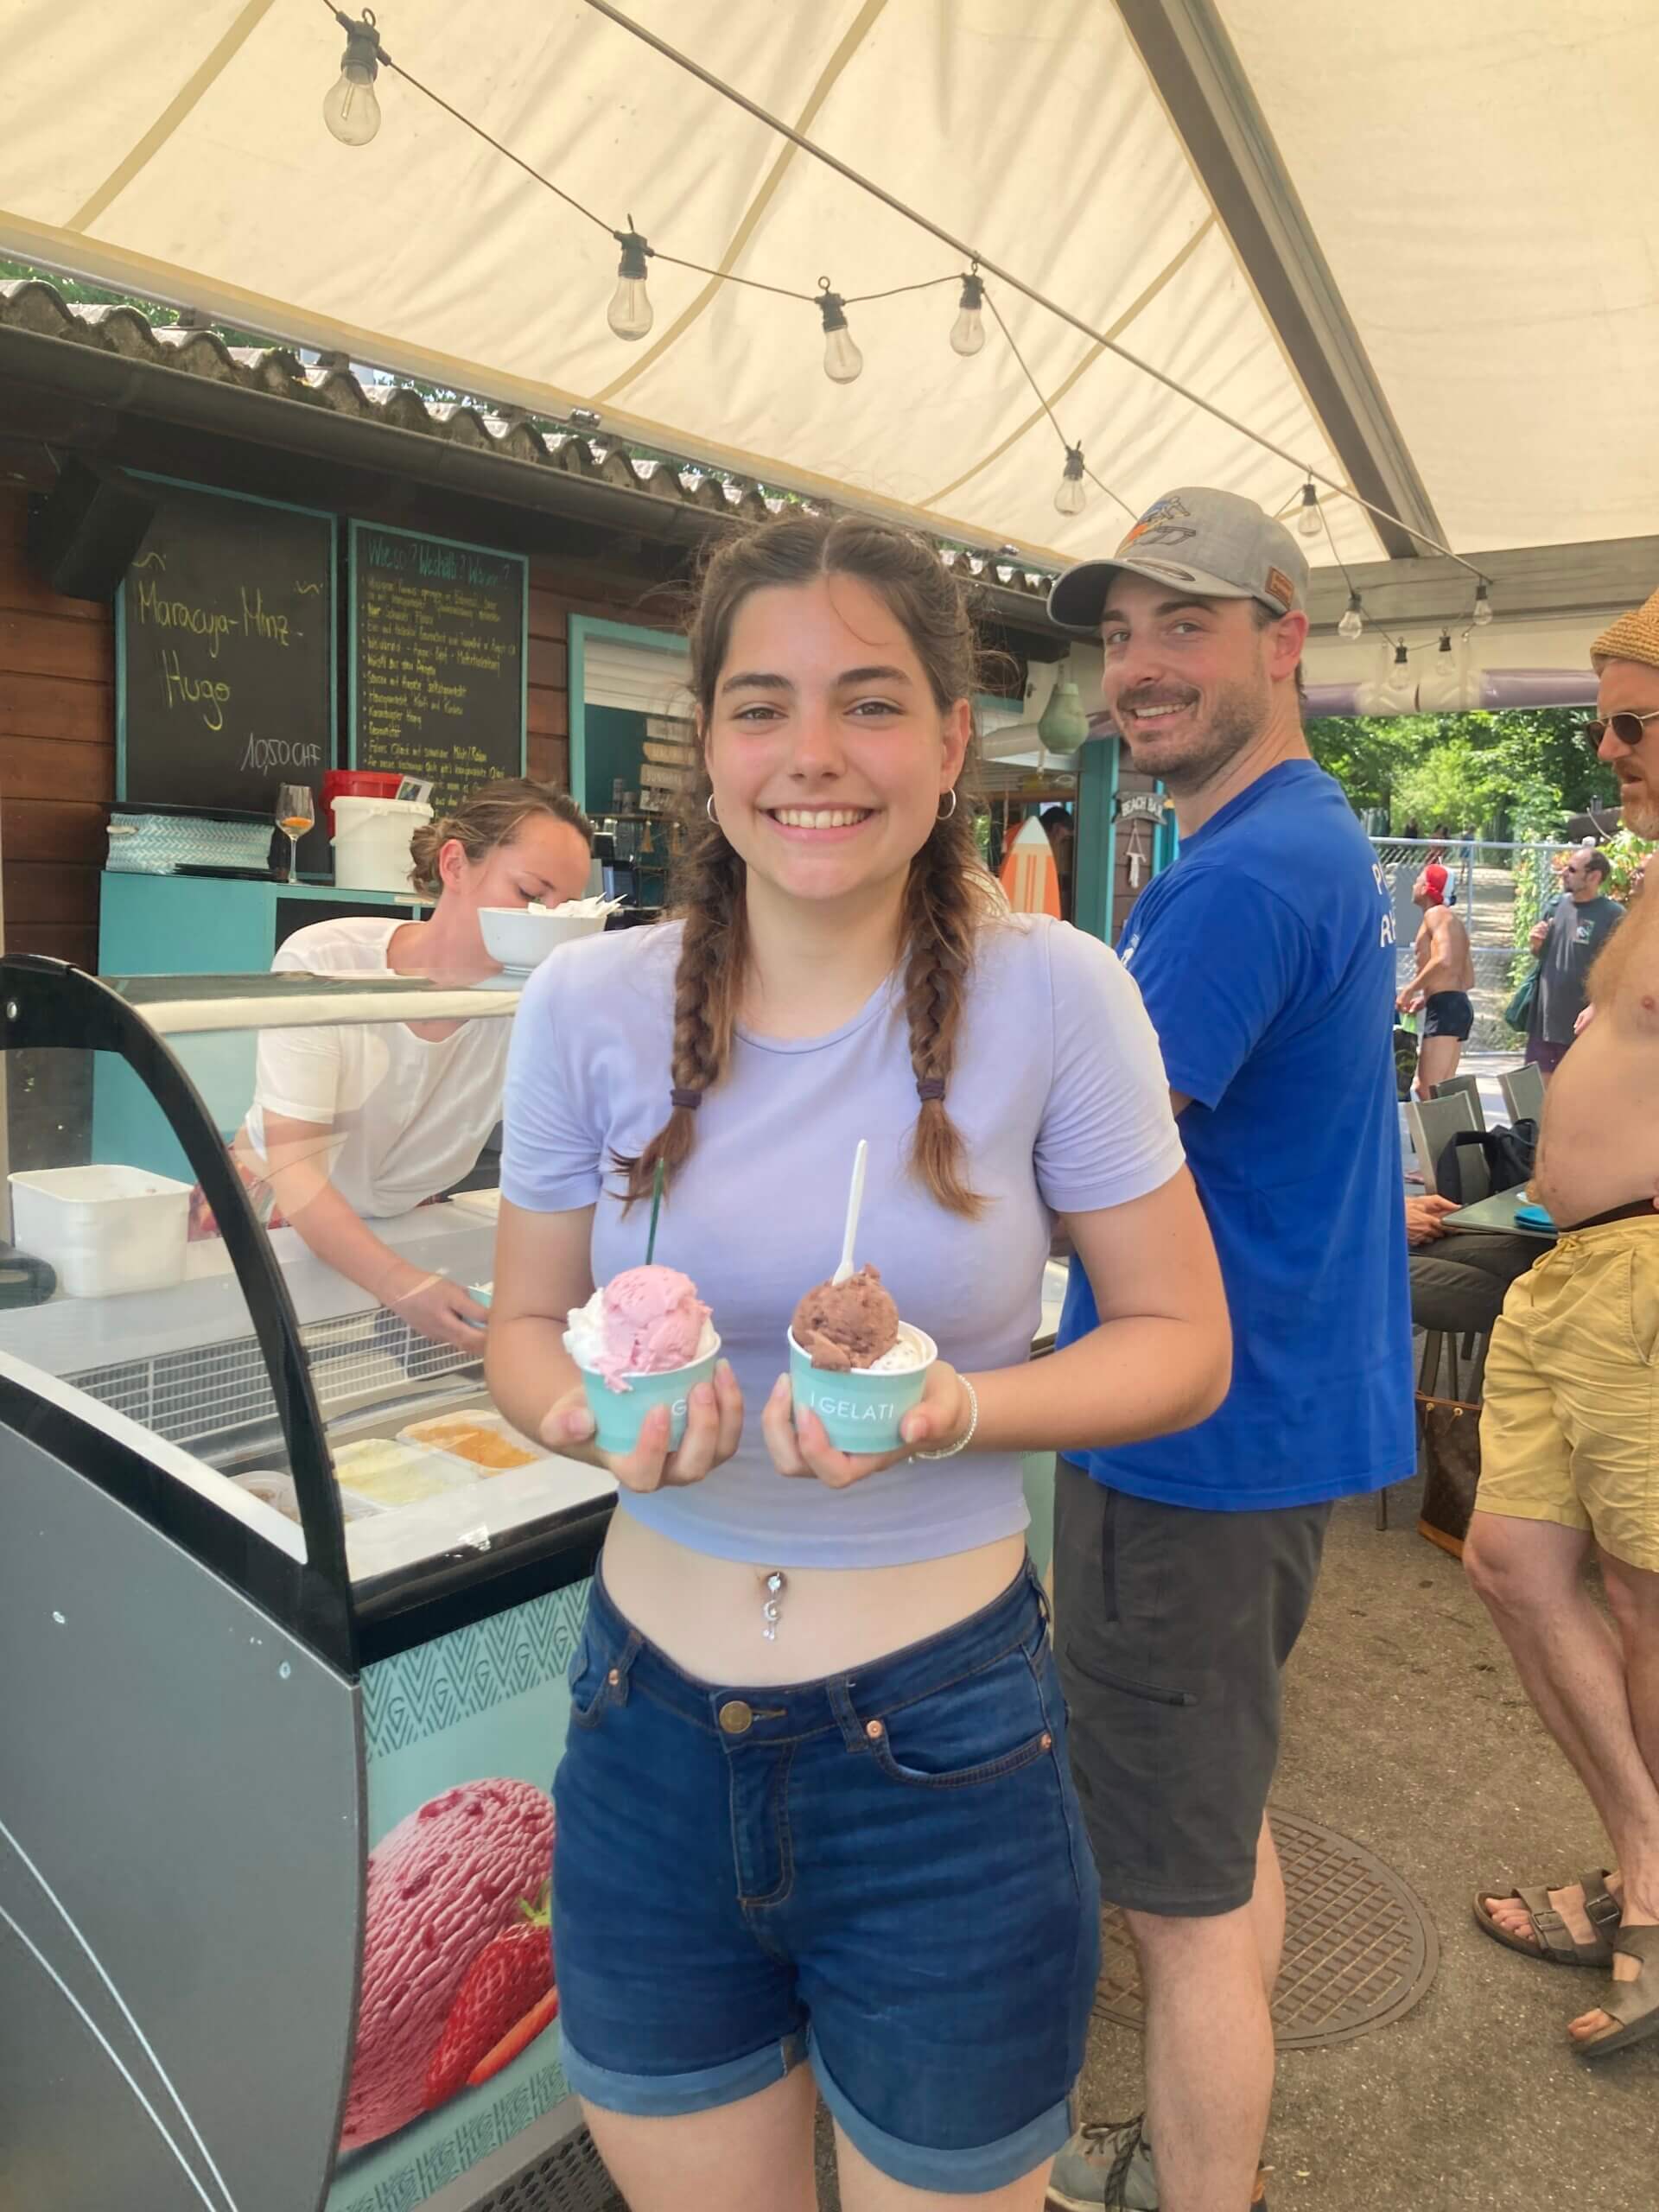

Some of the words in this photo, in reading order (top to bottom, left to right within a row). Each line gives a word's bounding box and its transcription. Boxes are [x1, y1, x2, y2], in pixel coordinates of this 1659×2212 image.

[162, 649, 231, 731] Hugo
[1121, 795, 1147, 817] BEACH
[1147, 797, 1163, 819] BAR
[819, 1395, 895, 1421] GELATI
